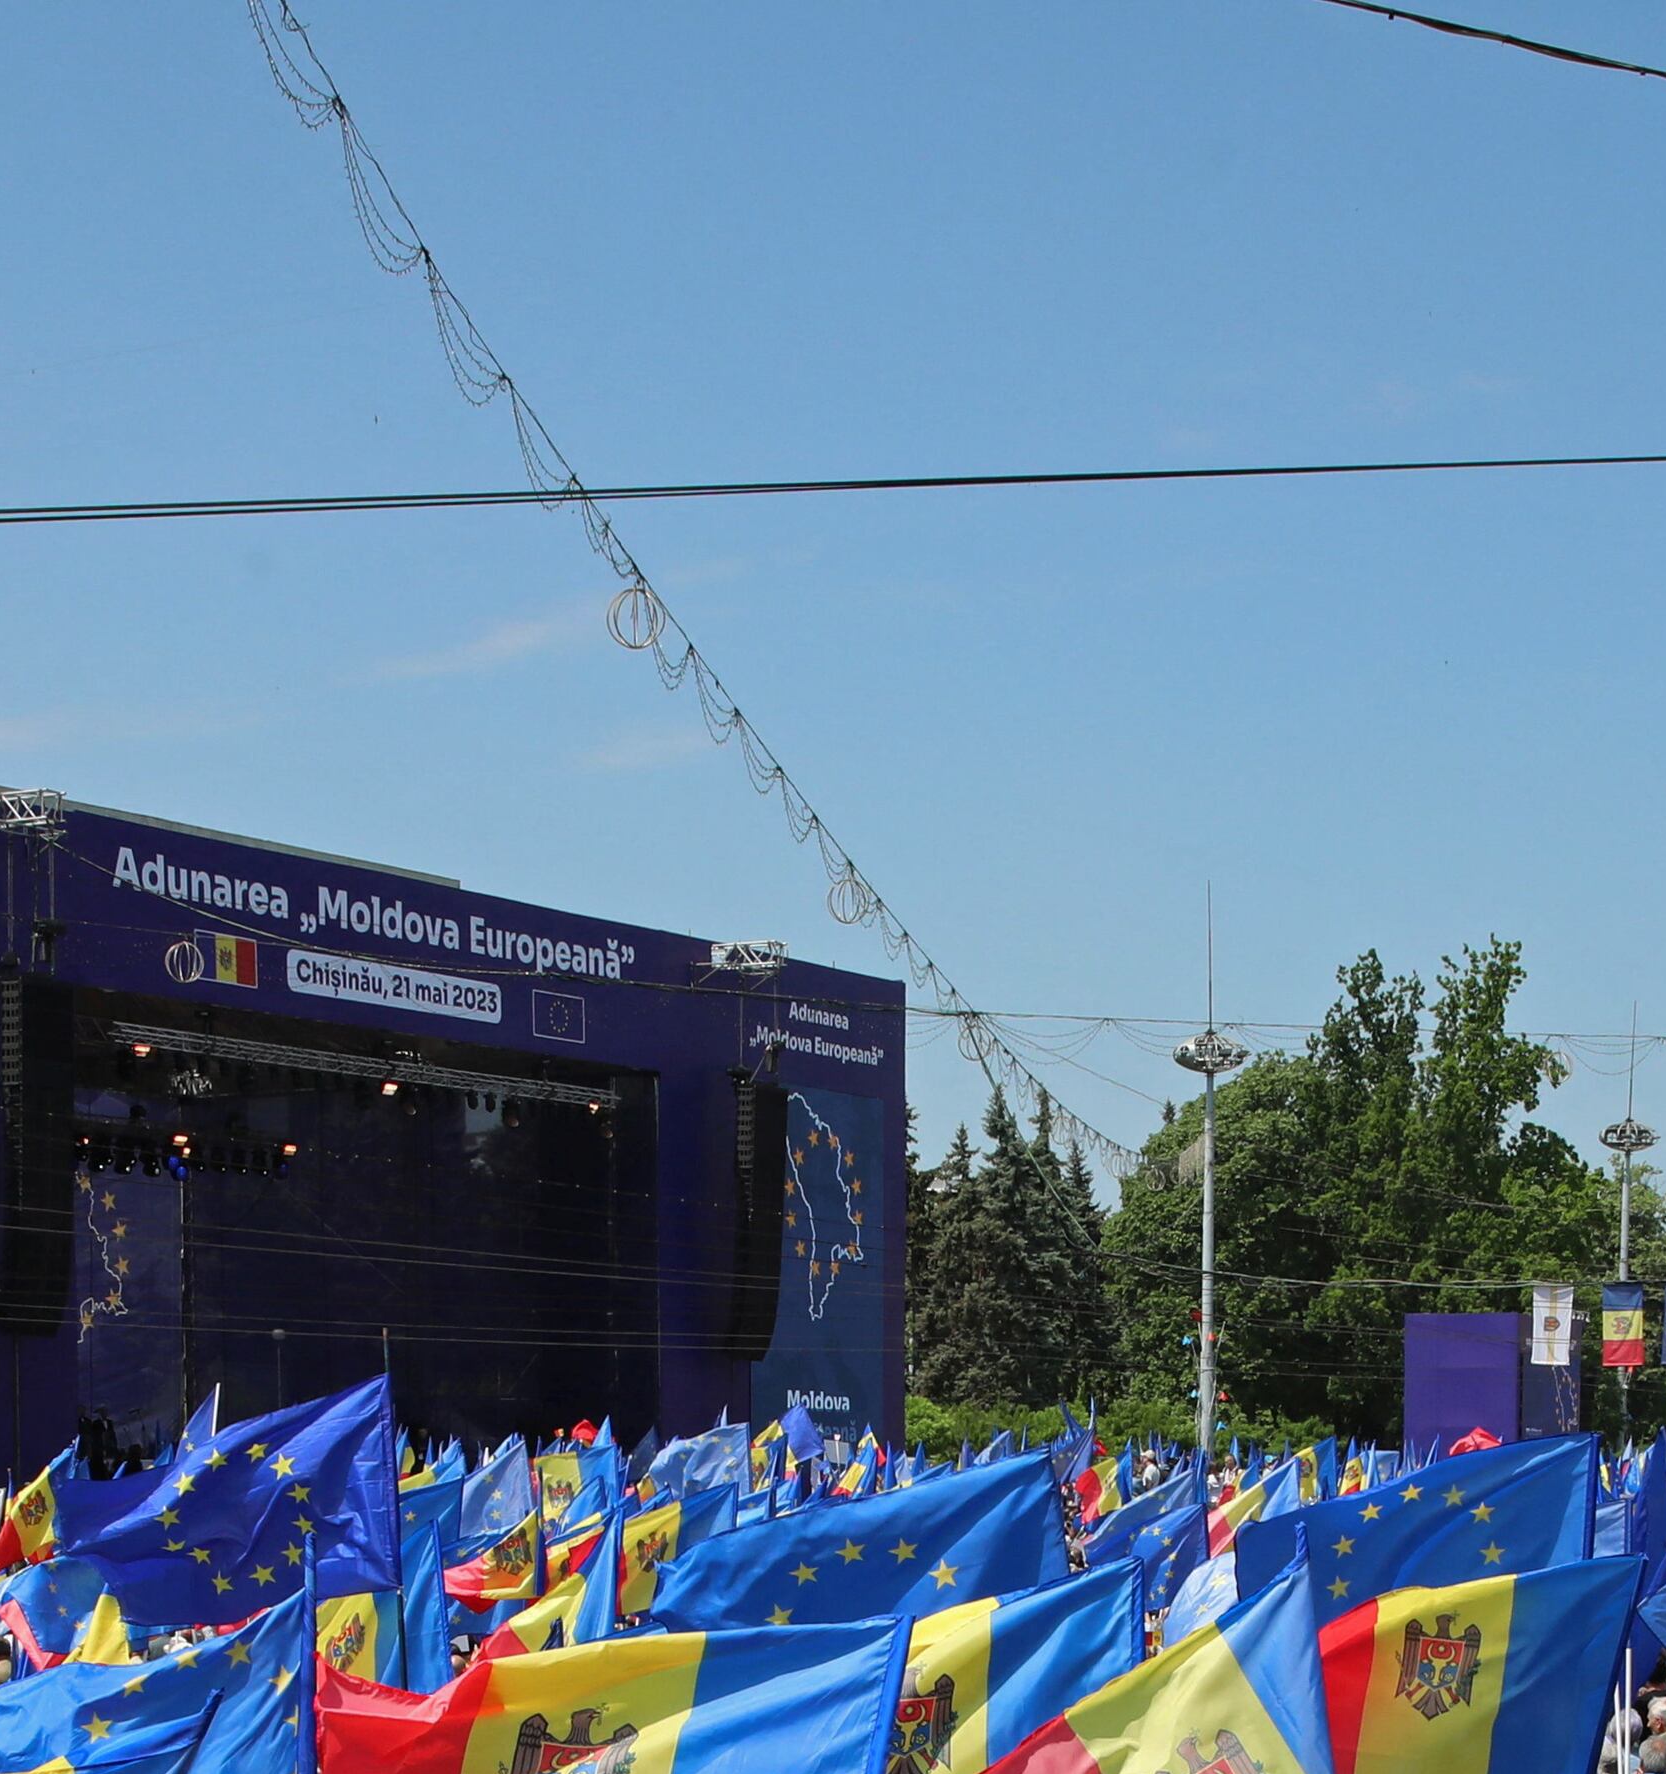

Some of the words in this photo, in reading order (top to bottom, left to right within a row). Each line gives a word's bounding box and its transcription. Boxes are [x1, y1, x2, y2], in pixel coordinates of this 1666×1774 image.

[112, 846, 289, 920] Adunarea
[300, 886, 460, 951] „Moldova
[469, 914, 635, 980] Europeană”
[296, 959, 388, 999] Chișinău,
[392, 974, 413, 999] 21
[415, 976, 449, 1007] mai
[452, 982, 499, 1014] 2023
[789, 1001, 850, 1030] Adunarea
[787, 1389, 851, 1412] Moldova
